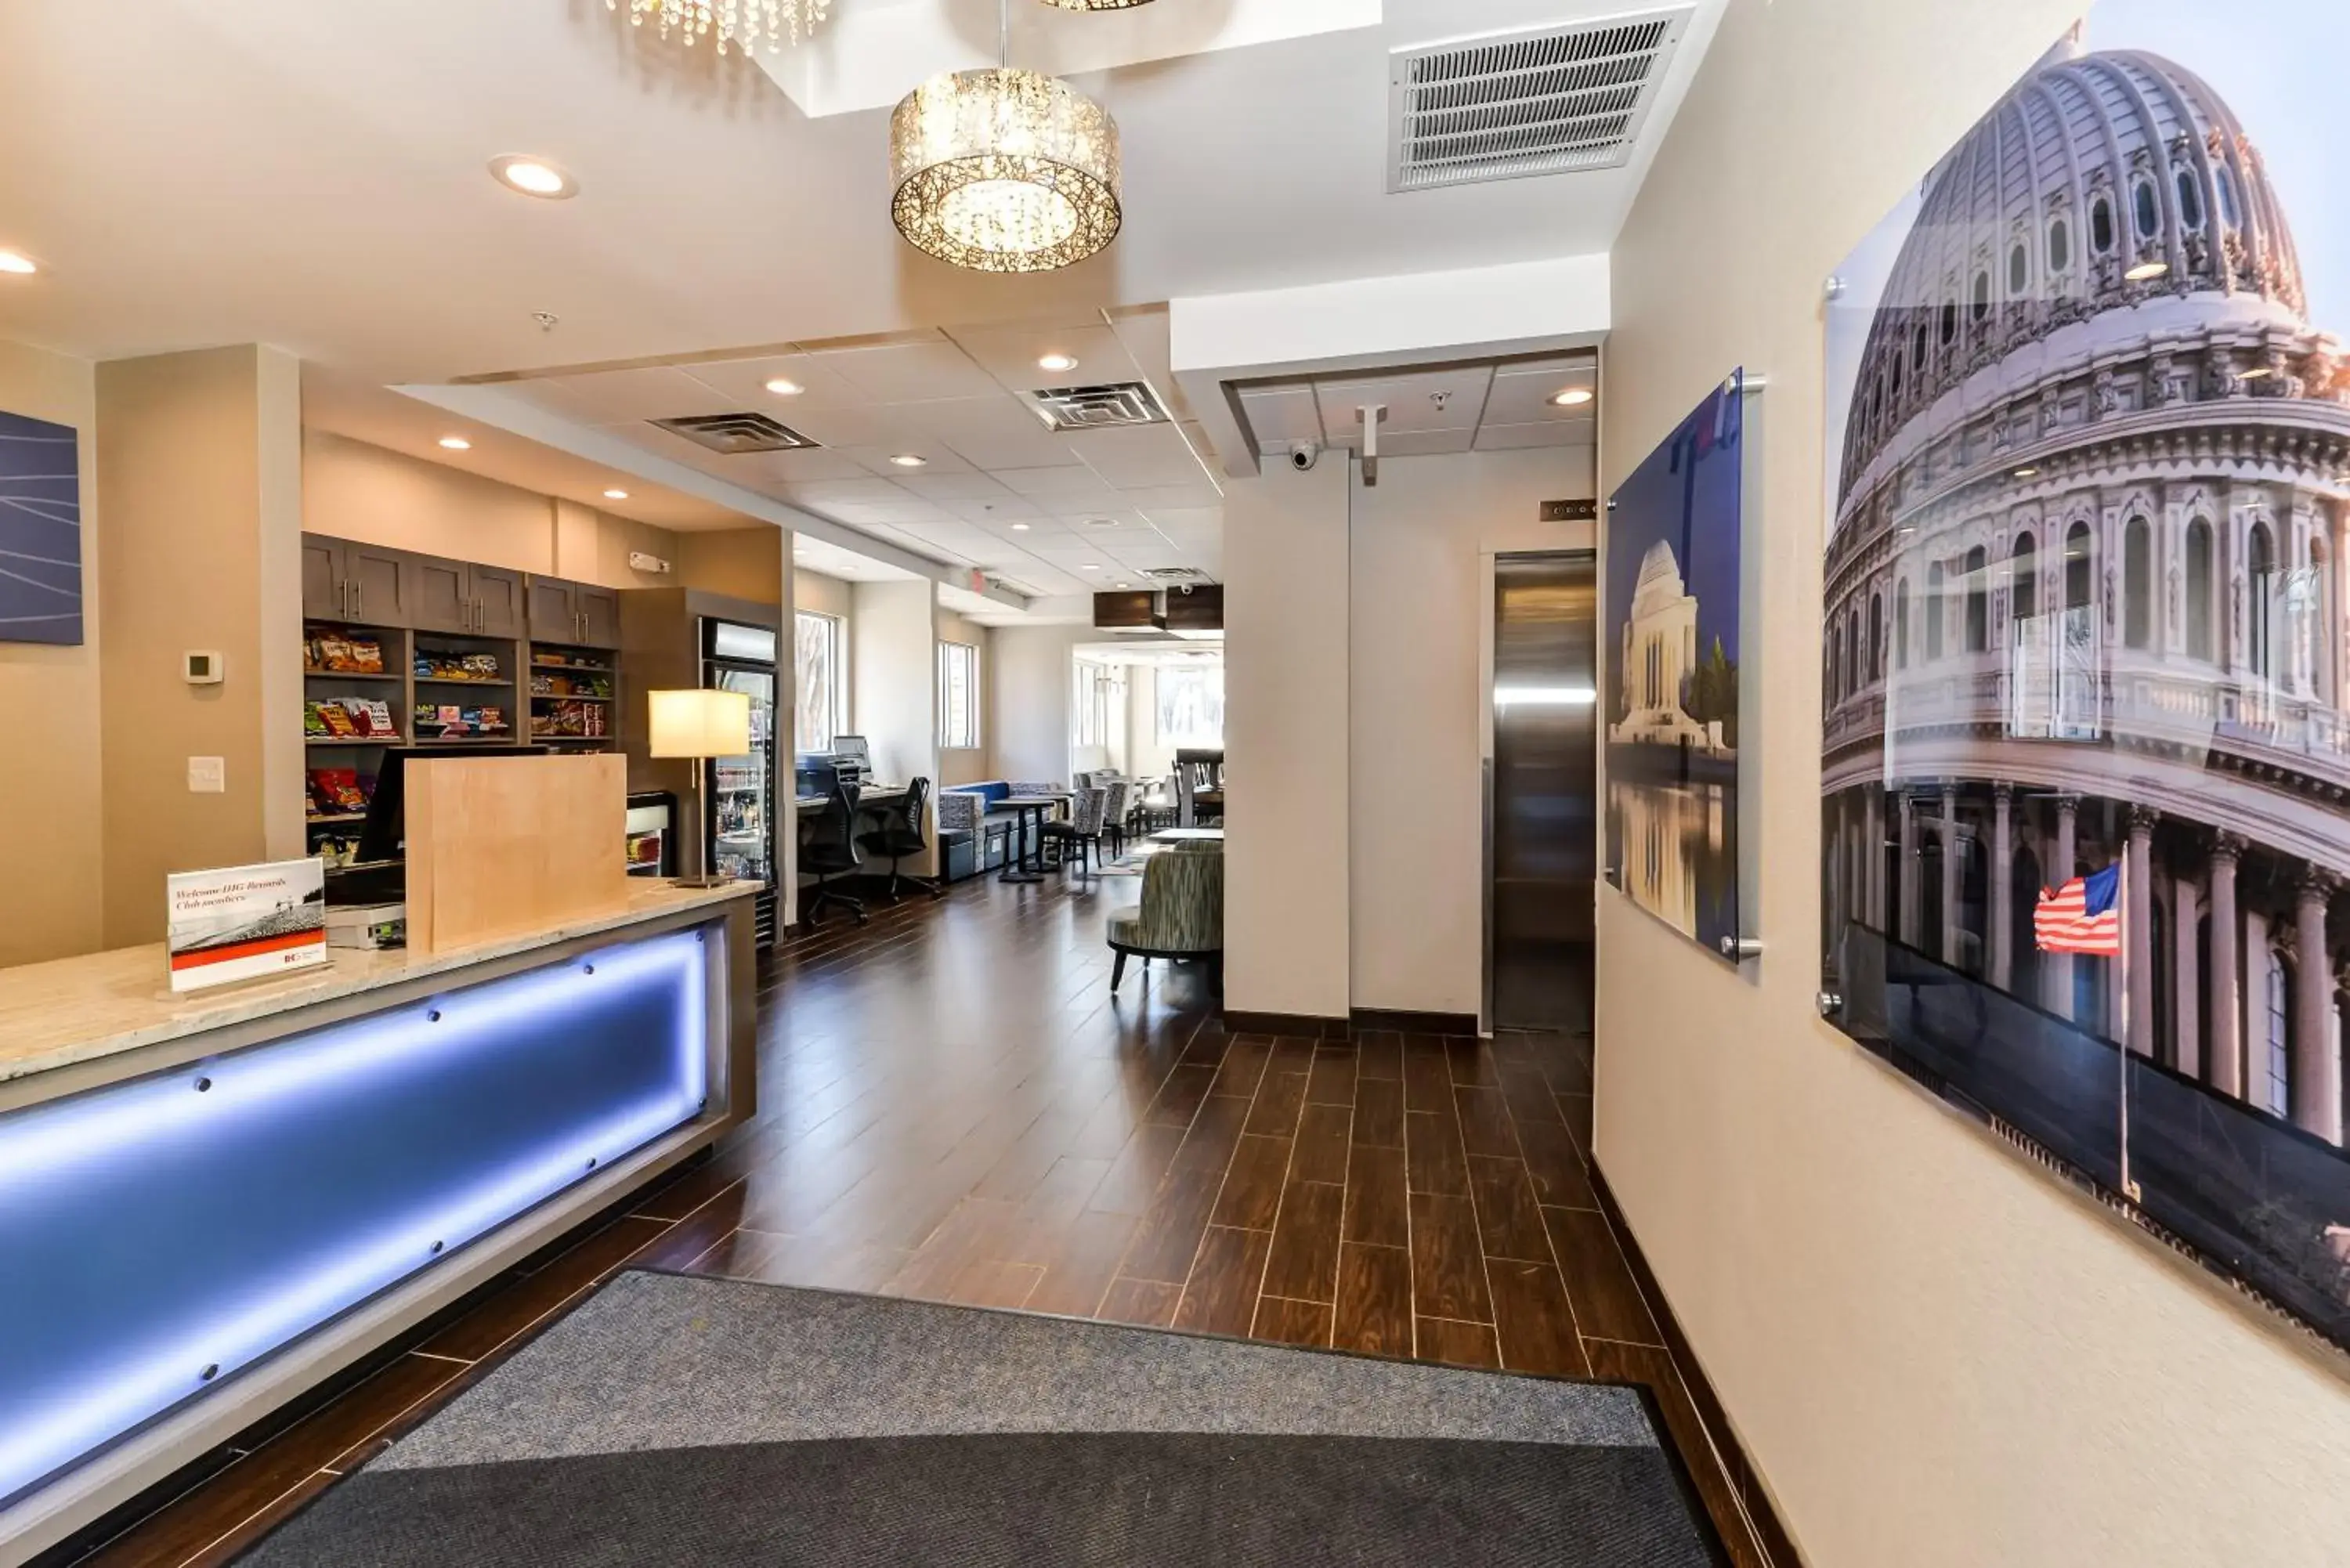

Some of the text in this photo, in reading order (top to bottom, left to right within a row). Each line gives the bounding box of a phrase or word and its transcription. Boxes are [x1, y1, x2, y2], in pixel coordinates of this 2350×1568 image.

[176, 888, 219, 899] Welcome
[247, 878, 286, 891] Rewards
[176, 894, 246, 910] Club members
